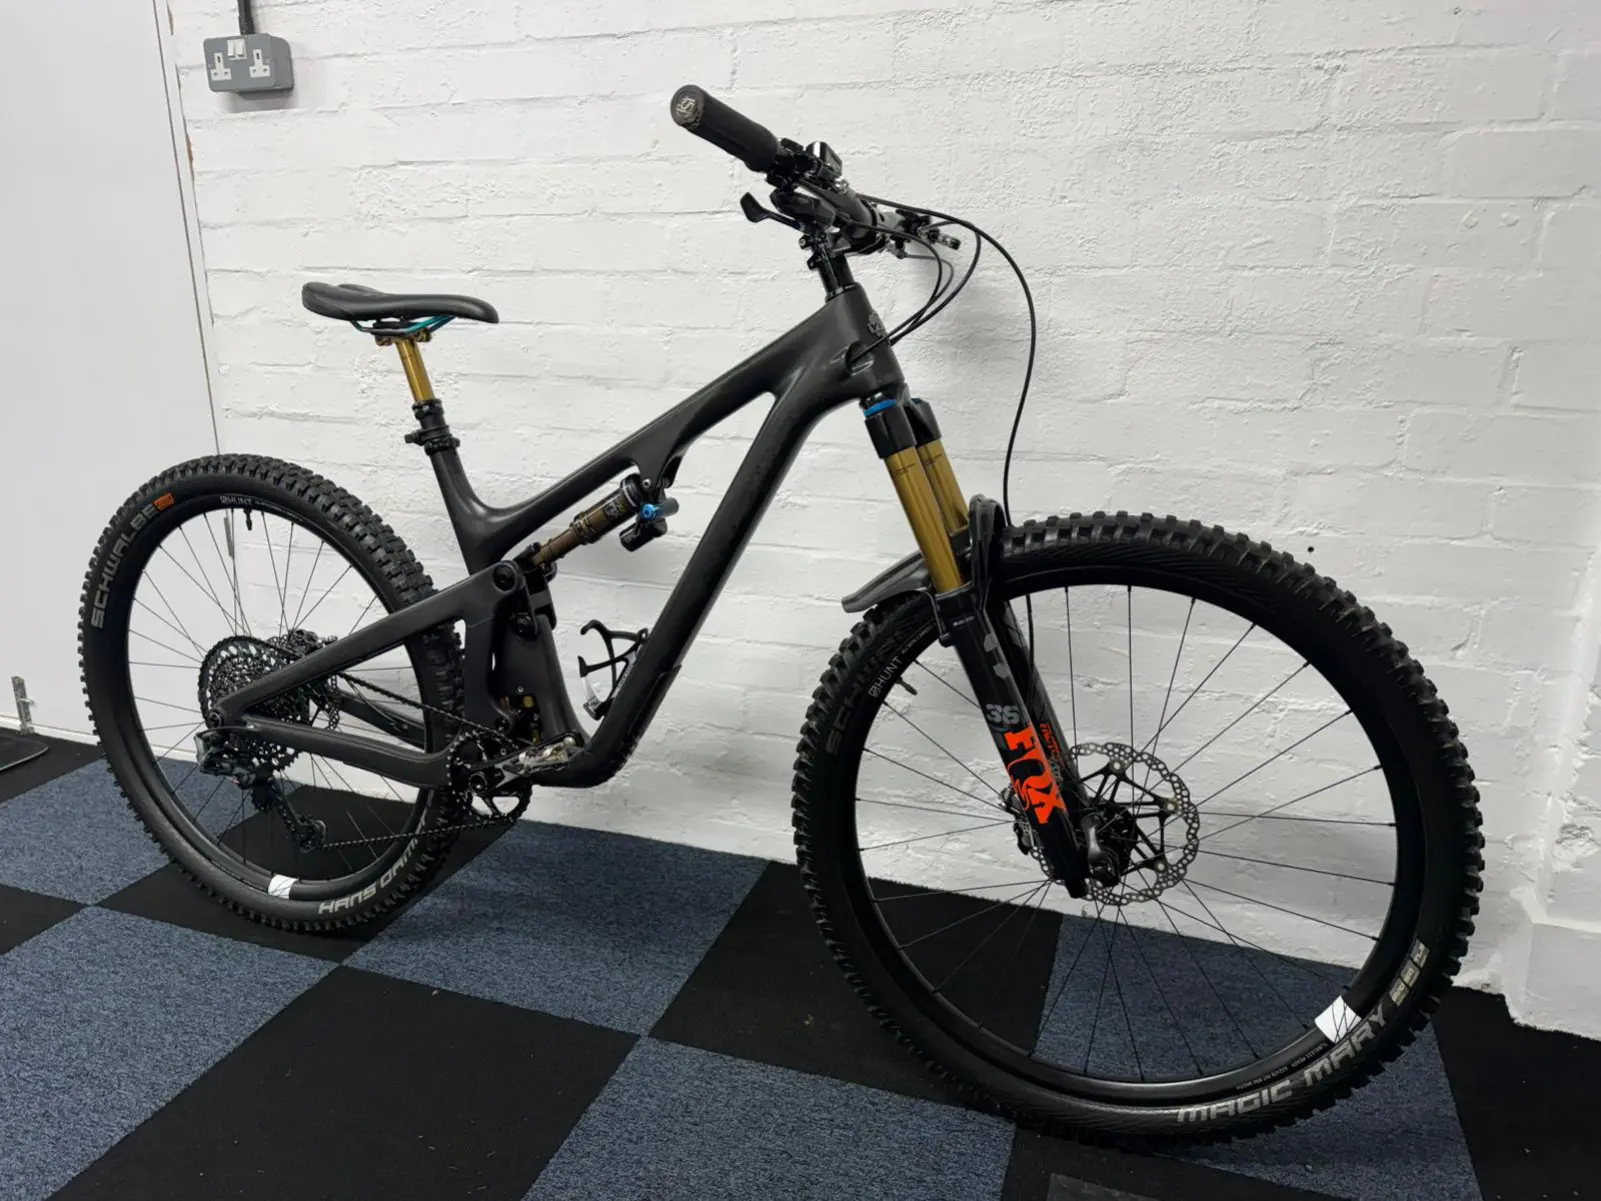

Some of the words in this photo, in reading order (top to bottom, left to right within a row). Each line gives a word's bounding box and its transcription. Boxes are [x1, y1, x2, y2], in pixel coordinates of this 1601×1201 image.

[91, 503, 160, 629] SCHWALBE
[873, 655, 903, 692] HUNT
[985, 703, 1020, 725] 36
[1004, 723, 1068, 824] FOX
[318, 883, 377, 914] HANS
[1177, 1079, 1293, 1122] MAGIC
[1304, 1003, 1386, 1086] MARY
